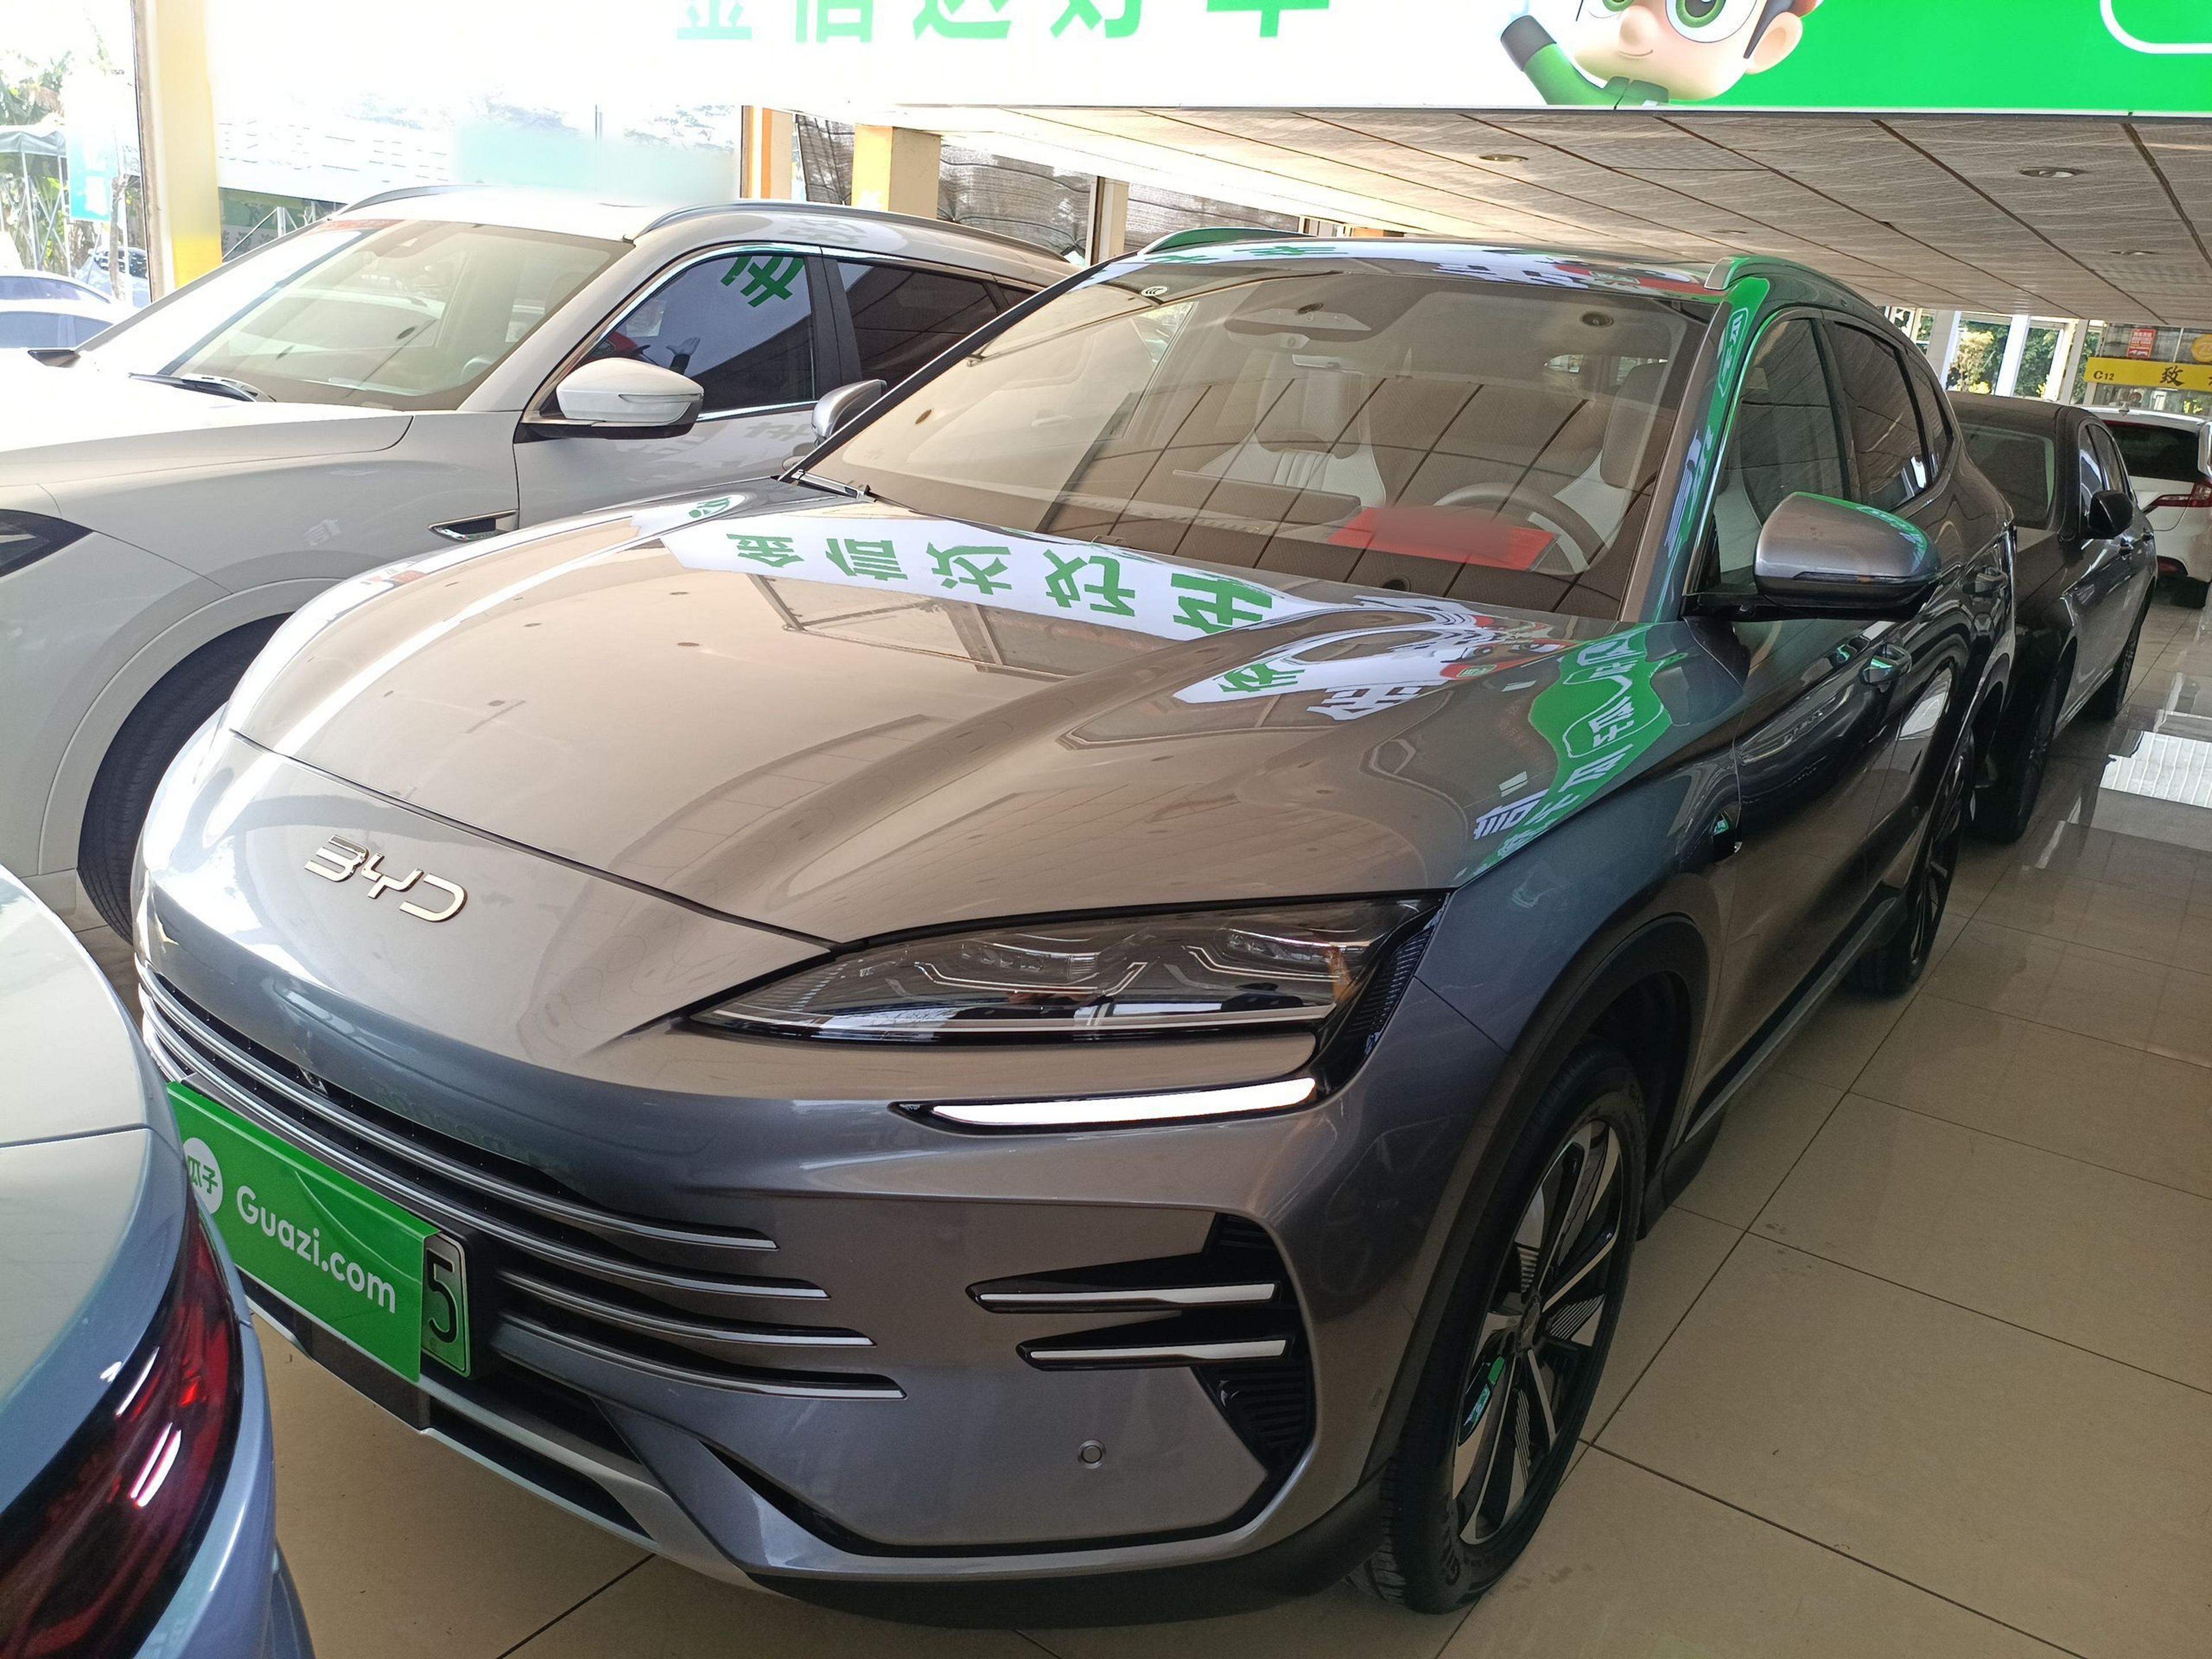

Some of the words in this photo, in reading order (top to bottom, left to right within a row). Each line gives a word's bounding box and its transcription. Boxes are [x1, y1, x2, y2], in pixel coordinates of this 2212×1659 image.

[2093, 370, 2115, 381] C12
[304, 835, 468, 923] BYD
[237, 1185, 396, 1314] Guazi.com
[426, 1249, 458, 1344] 5
